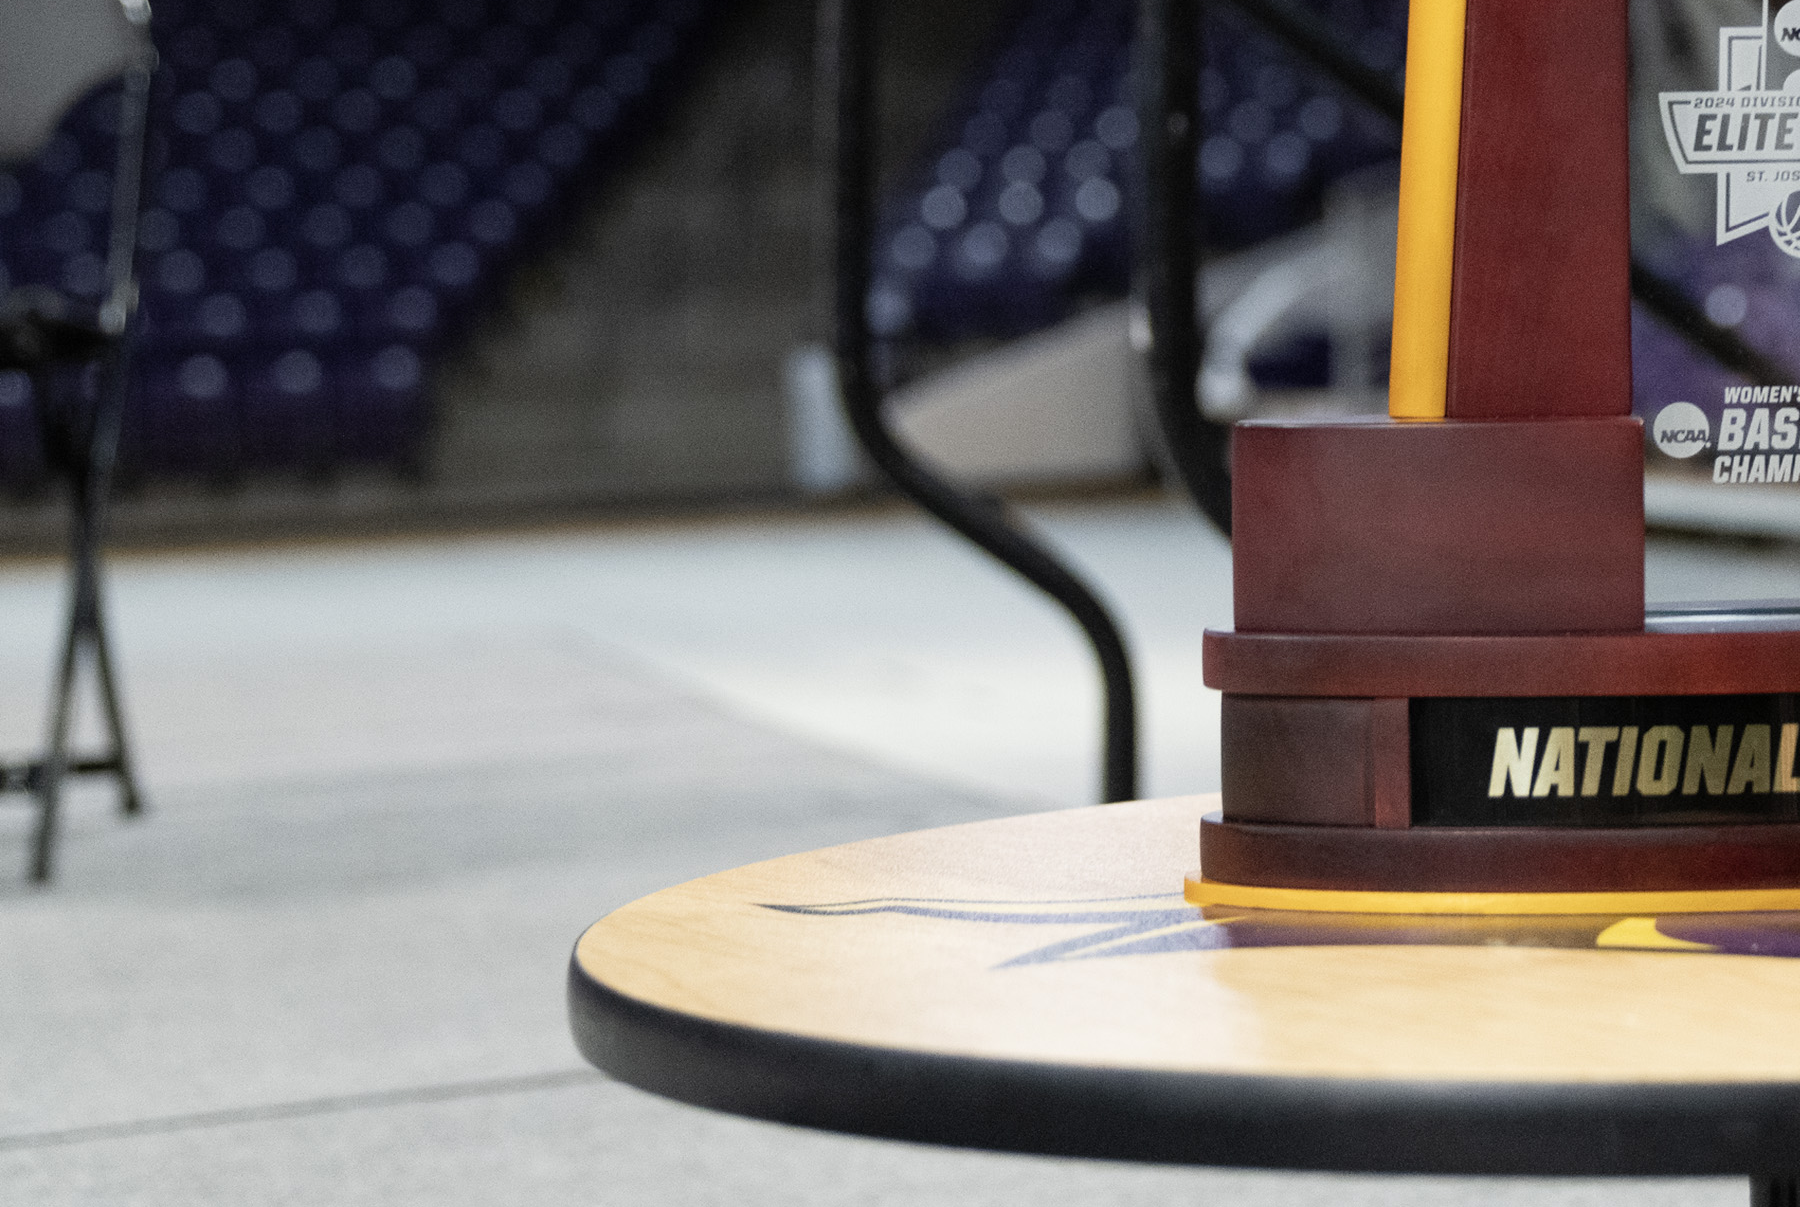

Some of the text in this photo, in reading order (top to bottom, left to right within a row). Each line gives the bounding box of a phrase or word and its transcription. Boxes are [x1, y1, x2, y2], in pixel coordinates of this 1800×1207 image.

[1693, 97, 1735, 109] 2024
[1693, 113, 1799, 152] ELITE
[1746, 171, 1768, 182] ST.
[1660, 429, 1706, 443] NCAA
